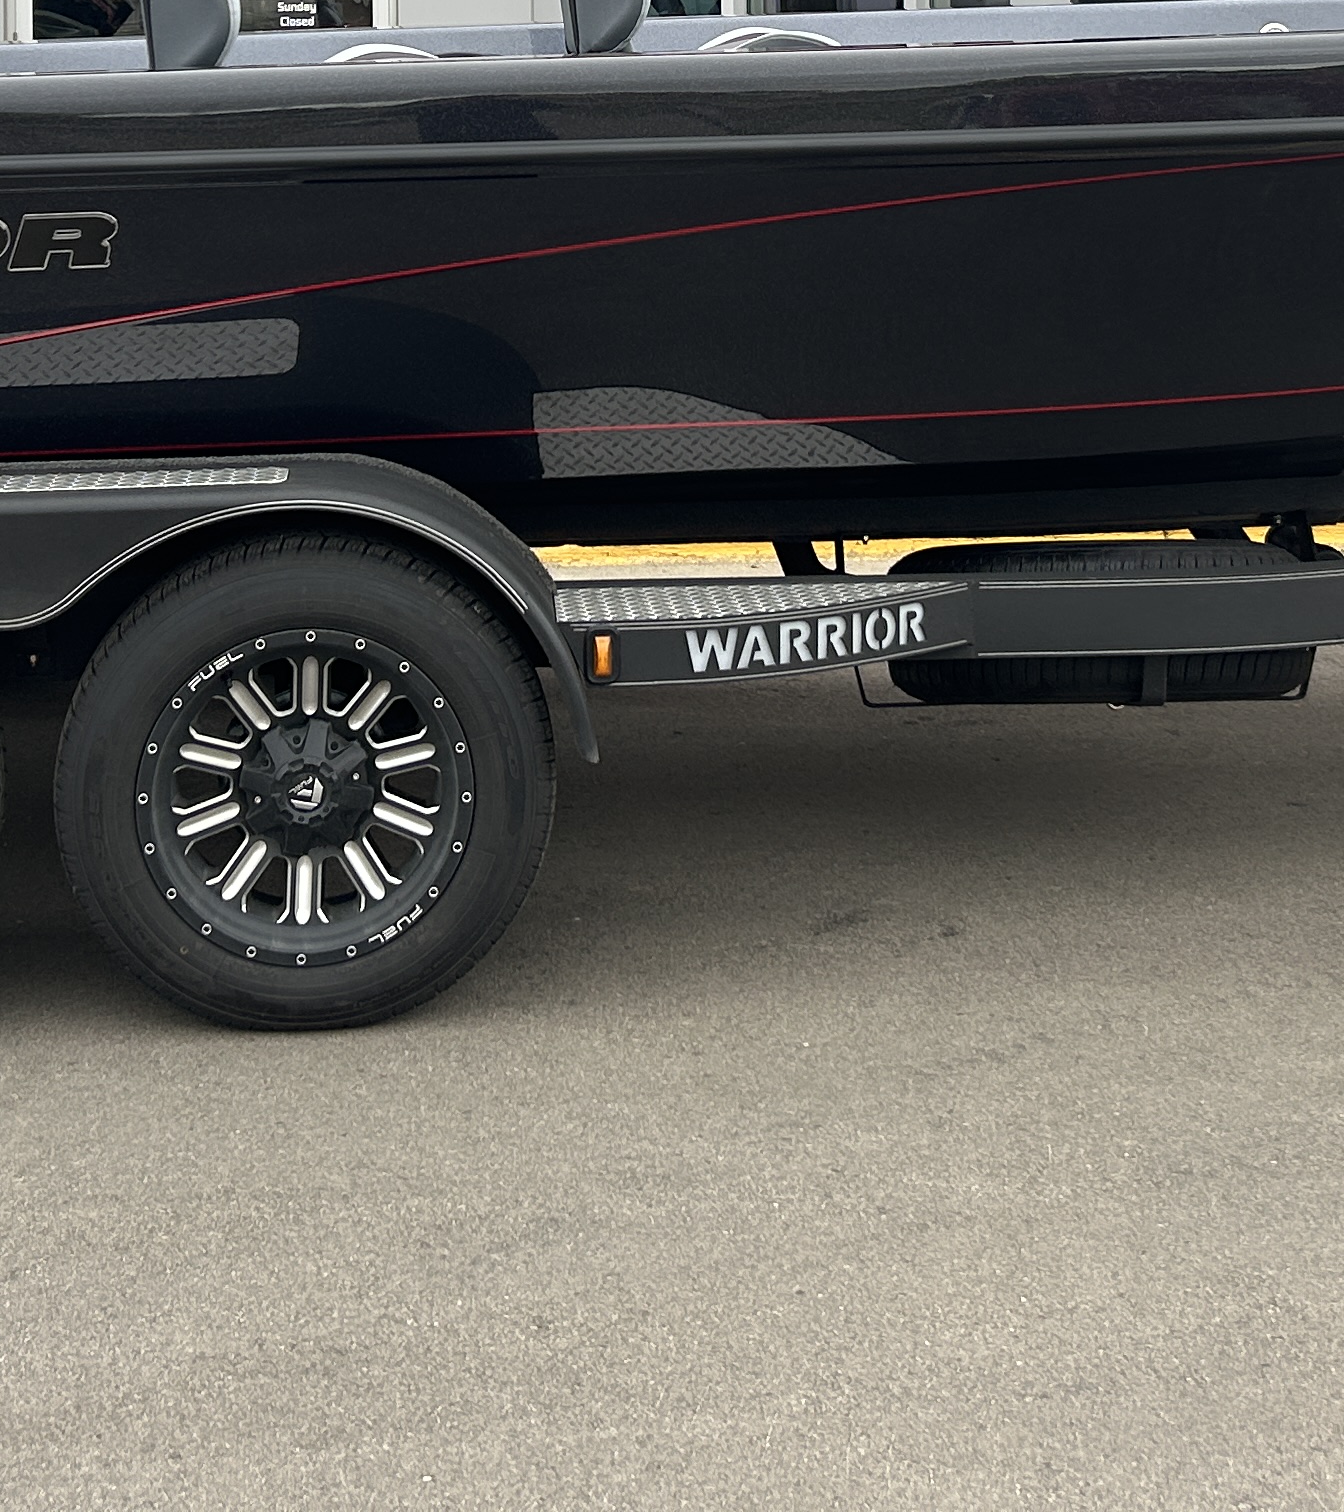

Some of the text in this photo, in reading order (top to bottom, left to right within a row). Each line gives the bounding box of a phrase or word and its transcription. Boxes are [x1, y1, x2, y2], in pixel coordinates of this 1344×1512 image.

[277, 2, 317, 14] Sunday
[279, 16, 315, 27] Closed
[685, 601, 927, 673] WARRIOR
[187, 652, 244, 692] FUEL
[368, 903, 423, 944] FUEL
